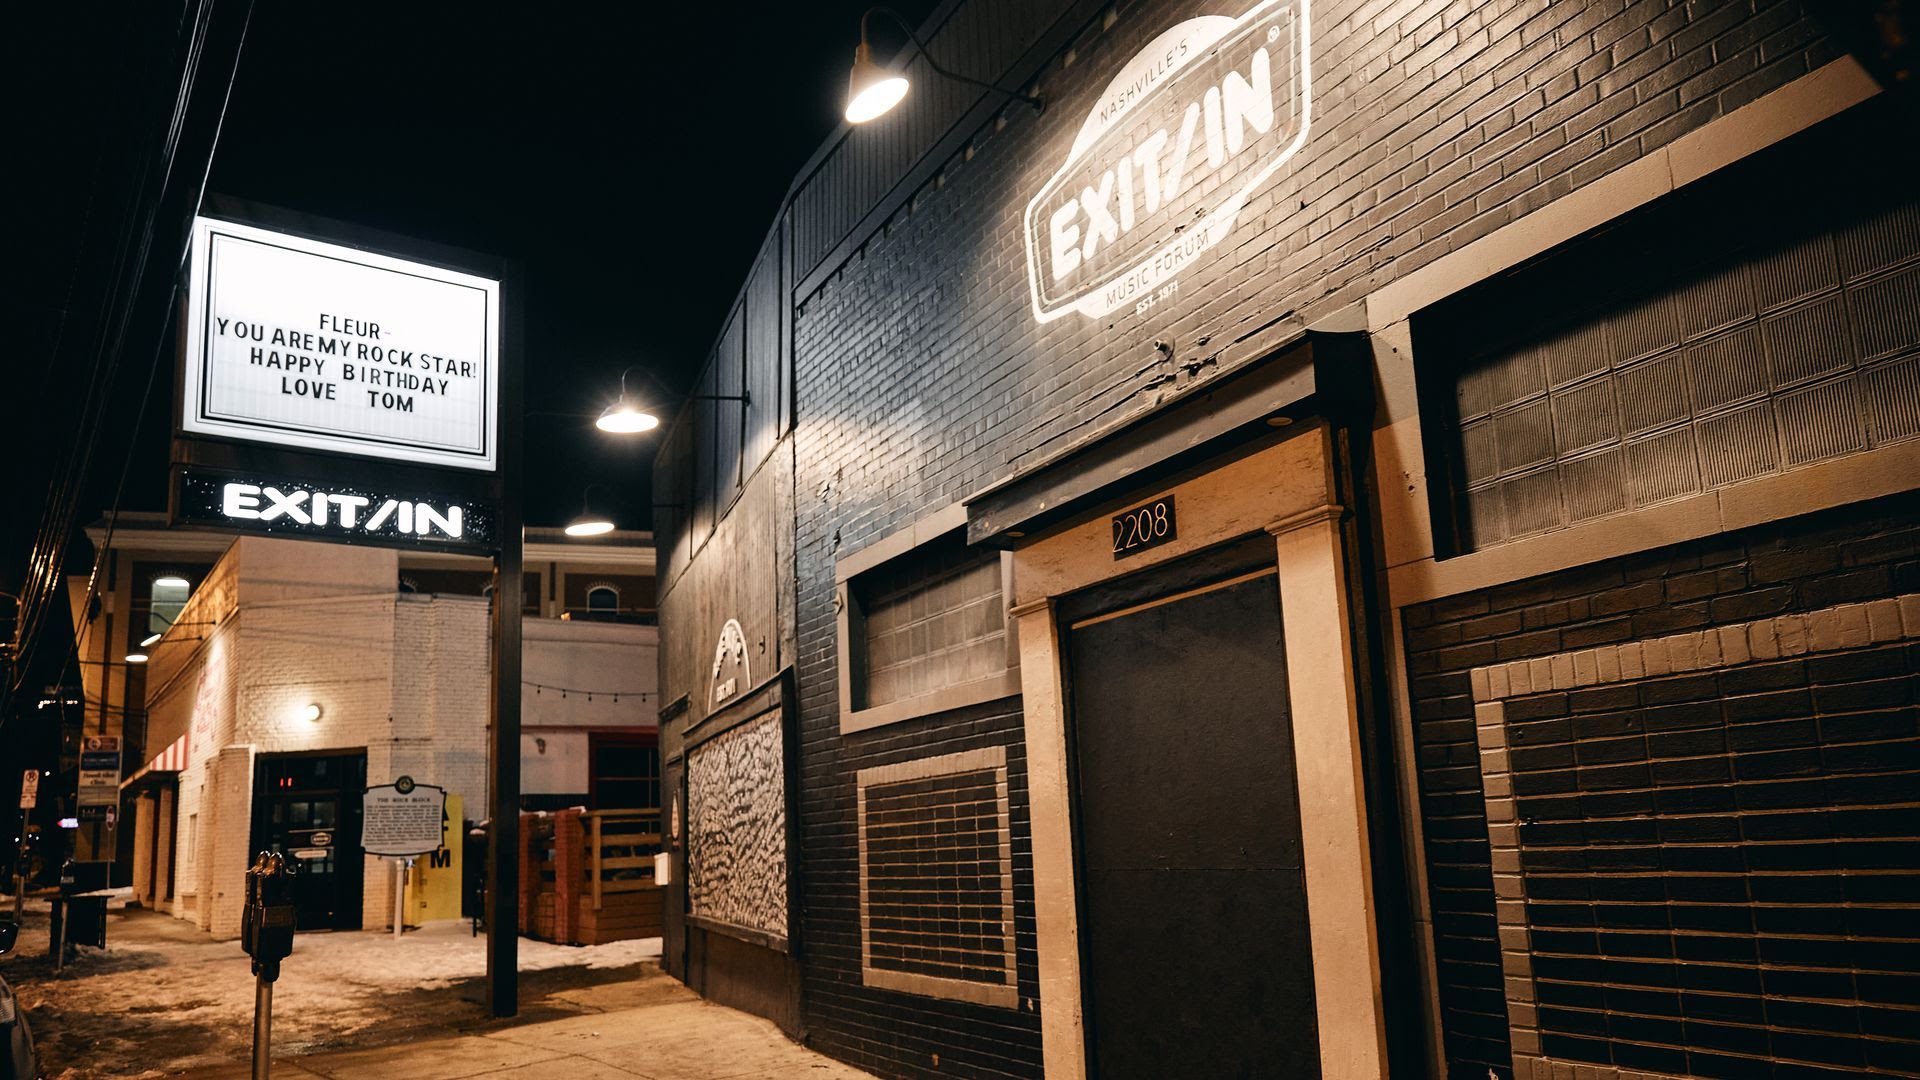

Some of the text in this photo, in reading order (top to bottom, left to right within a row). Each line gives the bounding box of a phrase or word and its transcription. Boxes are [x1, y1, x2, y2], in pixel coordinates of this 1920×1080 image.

[1100, 39, 1188, 124] NASHVILLE'S
[1050, 48, 1274, 281] EXIT/IN
[1105, 231, 1209, 309] MUSIC FORUM
[217, 317, 476, 378] YOU ARE MY ROCK STAR!
[250, 347, 449, 395] HAPPY BIRTHDAY
[281, 376, 413, 412] LOVE TOM
[223, 483, 462, 538] EXIT/IN
[1112, 503, 1168, 553] 2208
